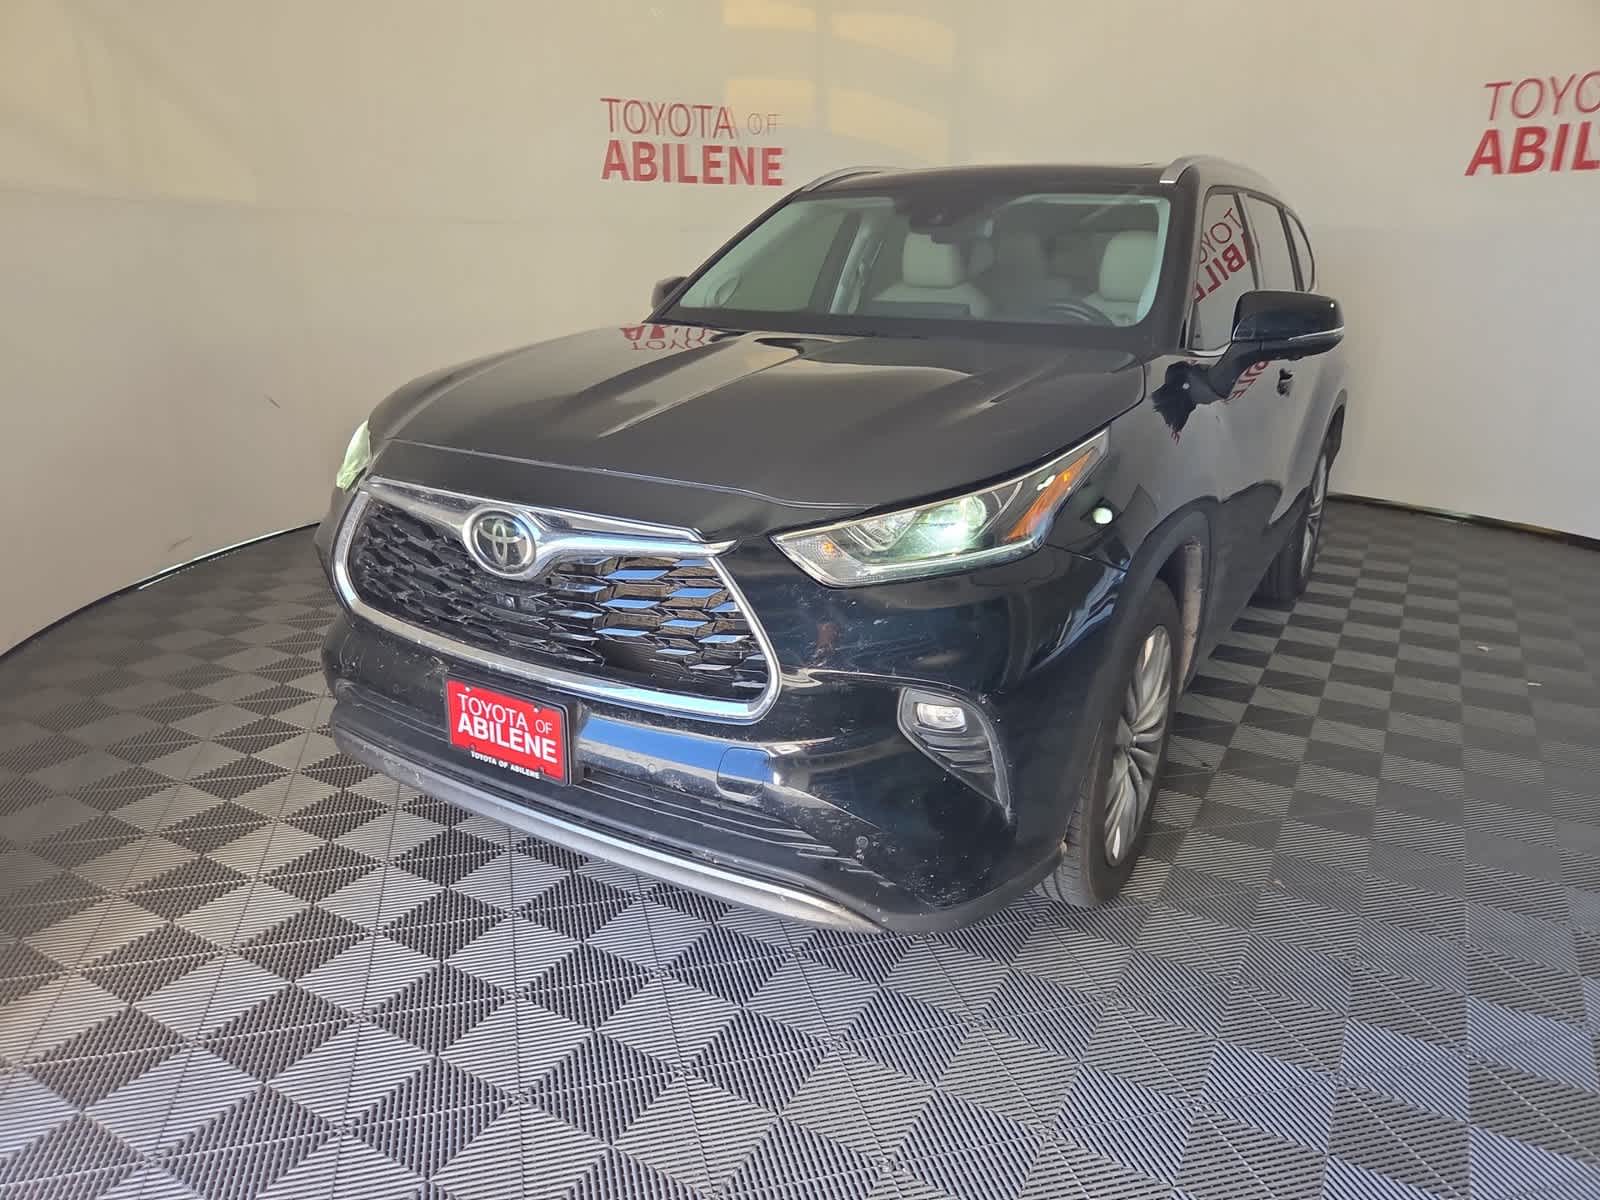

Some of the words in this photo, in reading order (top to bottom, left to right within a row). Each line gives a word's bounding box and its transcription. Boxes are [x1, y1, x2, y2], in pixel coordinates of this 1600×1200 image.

[600, 98, 735, 139] TOYOTA
[747, 112, 780, 136] OF
[601, 140, 784, 186] ABILENE
[457, 693, 529, 731] TOYOTA
[535, 719, 553, 734] OF
[457, 713, 558, 764] ABILENE
[470, 750, 497, 765] TOYOTA
[498, 759, 509, 768] OF
[510, 764, 541, 780] ABILENE
